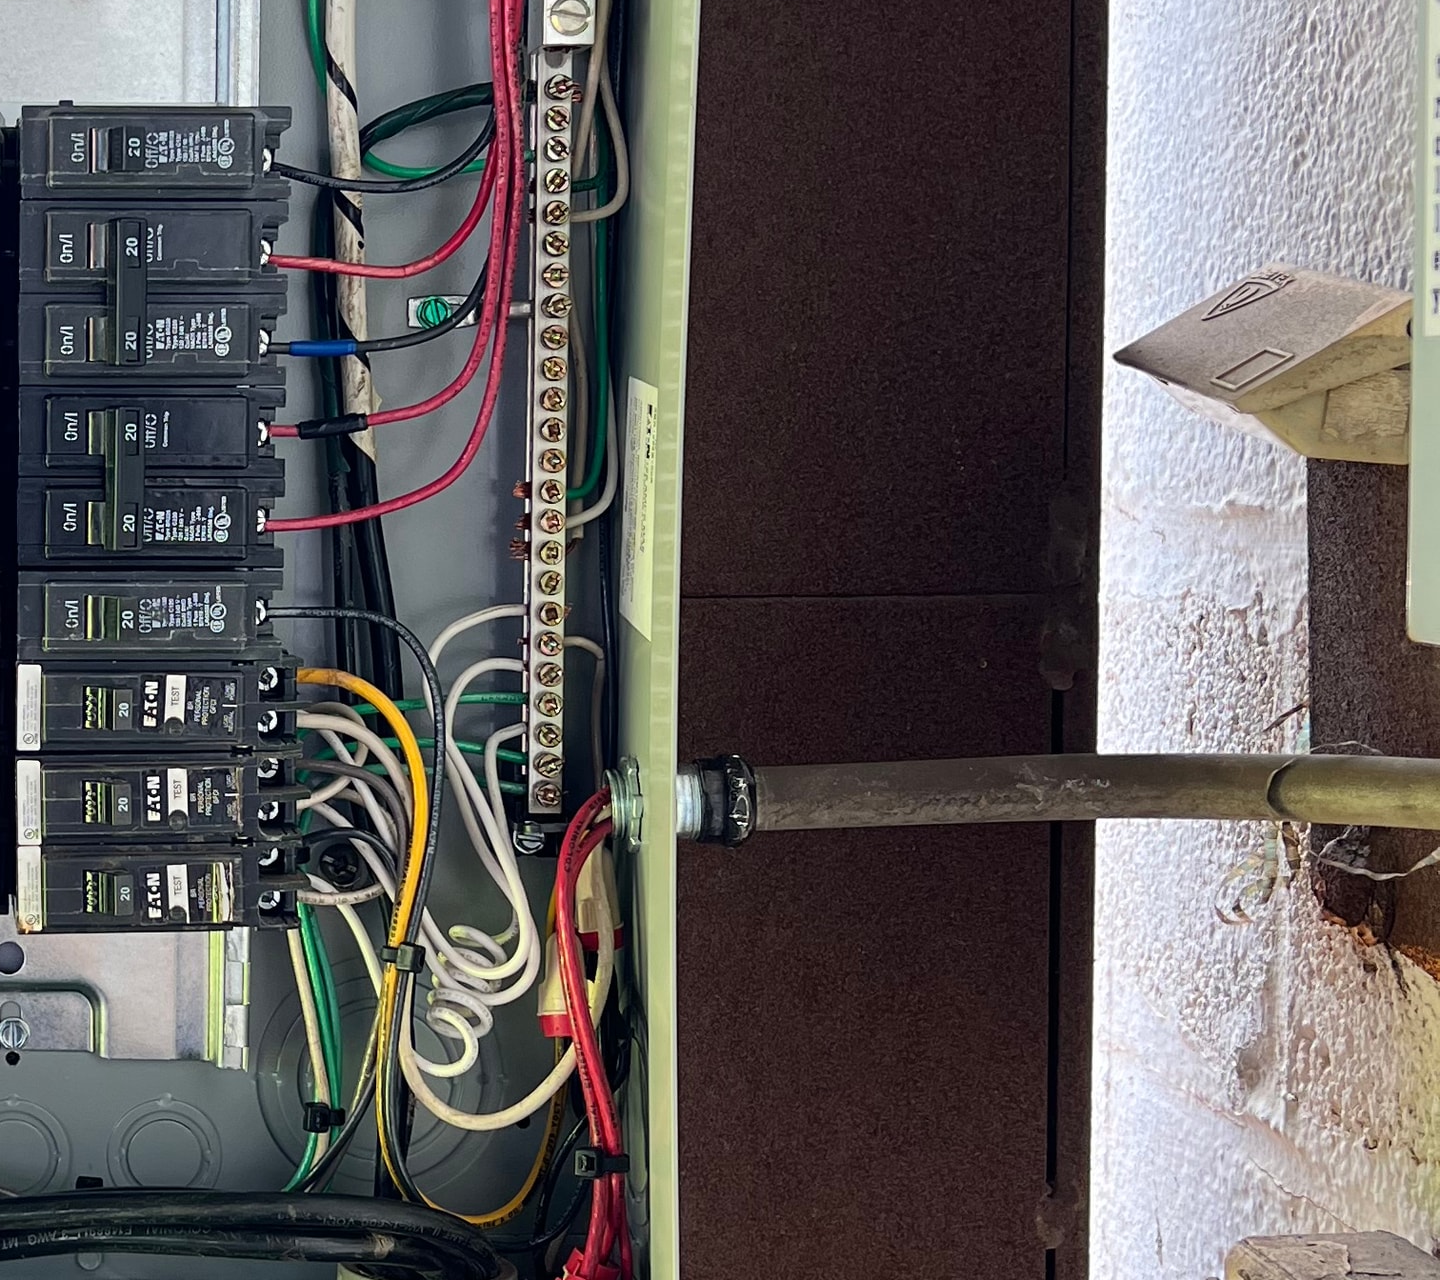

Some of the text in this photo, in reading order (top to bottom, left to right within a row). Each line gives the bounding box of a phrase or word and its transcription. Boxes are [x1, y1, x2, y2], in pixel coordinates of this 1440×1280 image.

[128, 137, 141, 157] 20
[126, 237, 138, 257] 20
[125, 331, 137, 351] 20
[125, 423, 137, 442] 20
[123, 514, 135, 532] 20
[122, 610, 134, 629] 20
[143, 681, 159, 727] EATON
[171, 686, 180, 706] TEST
[193, 690, 202, 722] PERSONAL
[118, 702, 130, 718] 20
[146, 776, 161, 822] EATON
[172, 780, 182, 800] TEST
[197, 781, 205, 813] PERSONAL
[118, 797, 129, 812] 20
[563, 818, 586, 873] COLONIAL
[119, 886, 130, 901] 20
[146, 873, 162, 919] EATON
[172, 876, 182, 896] TEST
[196, 877, 205, 909] PERSONAL
